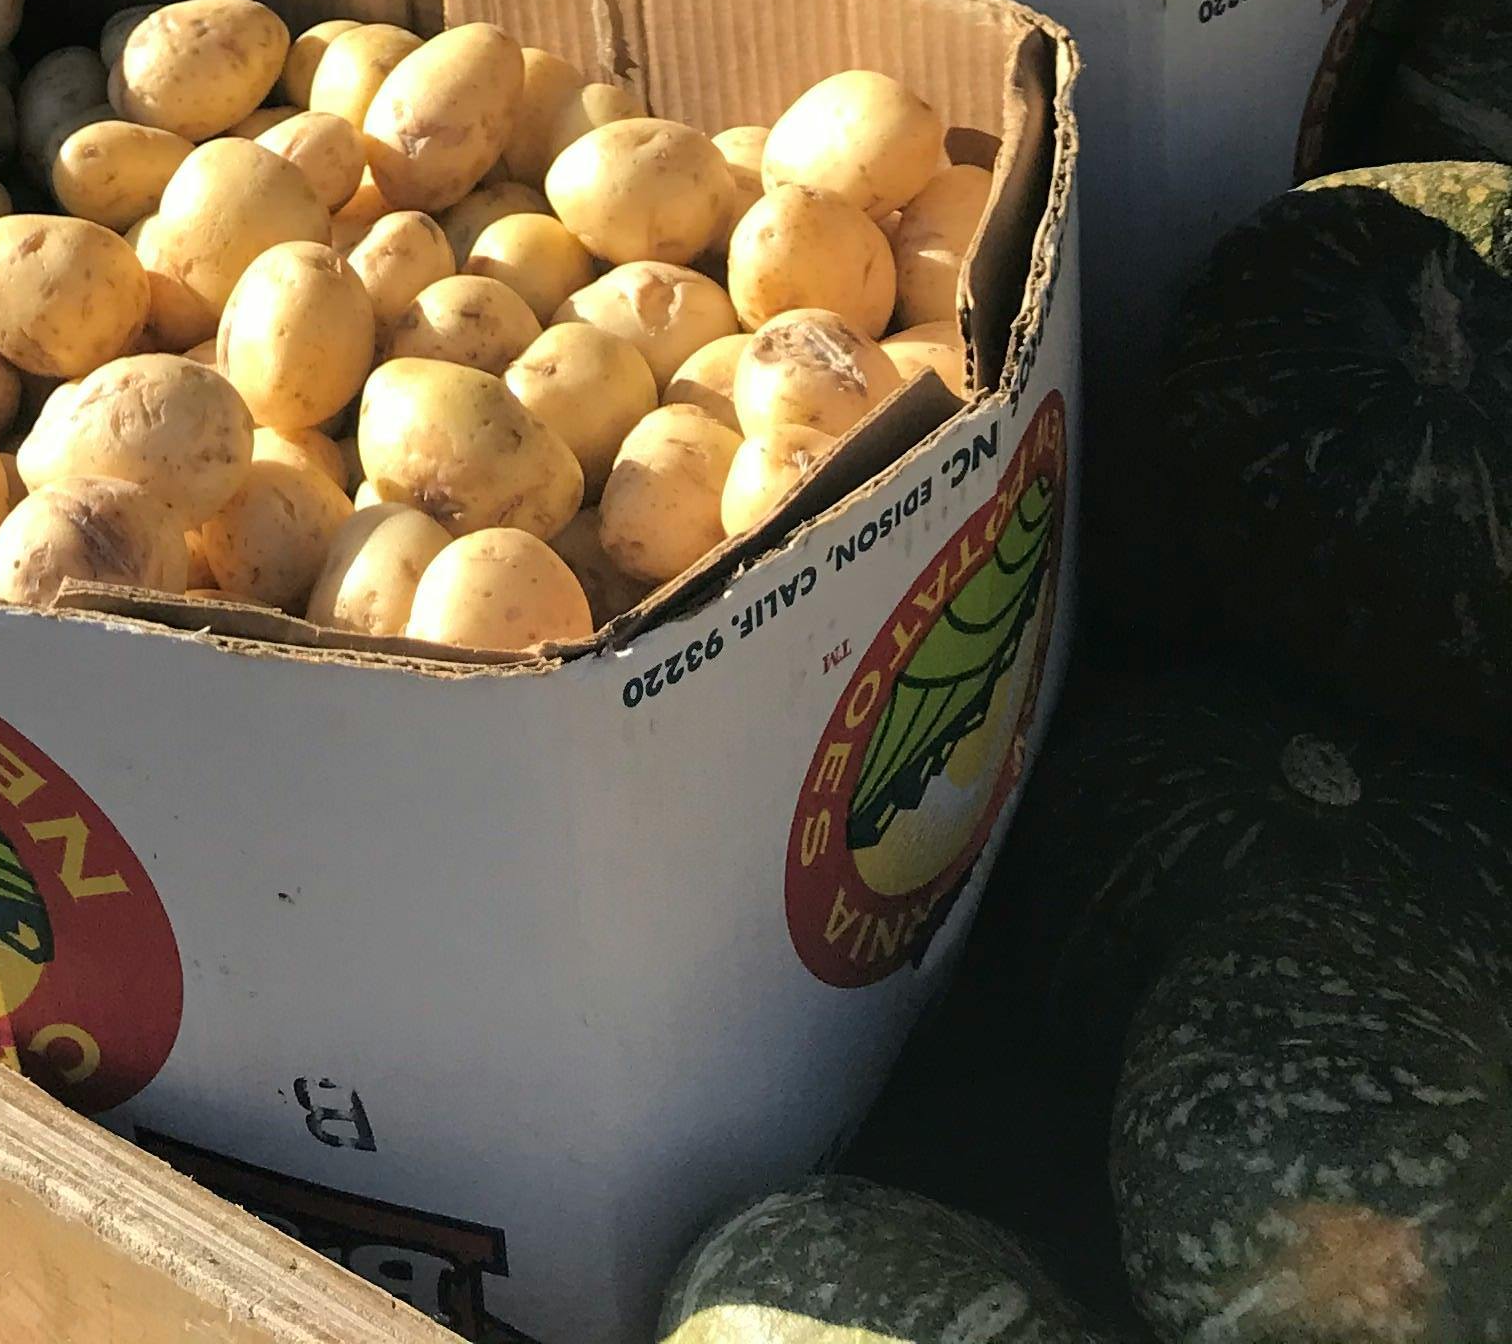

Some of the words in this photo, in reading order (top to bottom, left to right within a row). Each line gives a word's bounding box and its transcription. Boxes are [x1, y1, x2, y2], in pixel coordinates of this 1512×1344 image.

[826, 485, 933, 572] EDISON,
[739, 572, 818, 639] CALIF.
[621, 633, 725, 708] 93220
